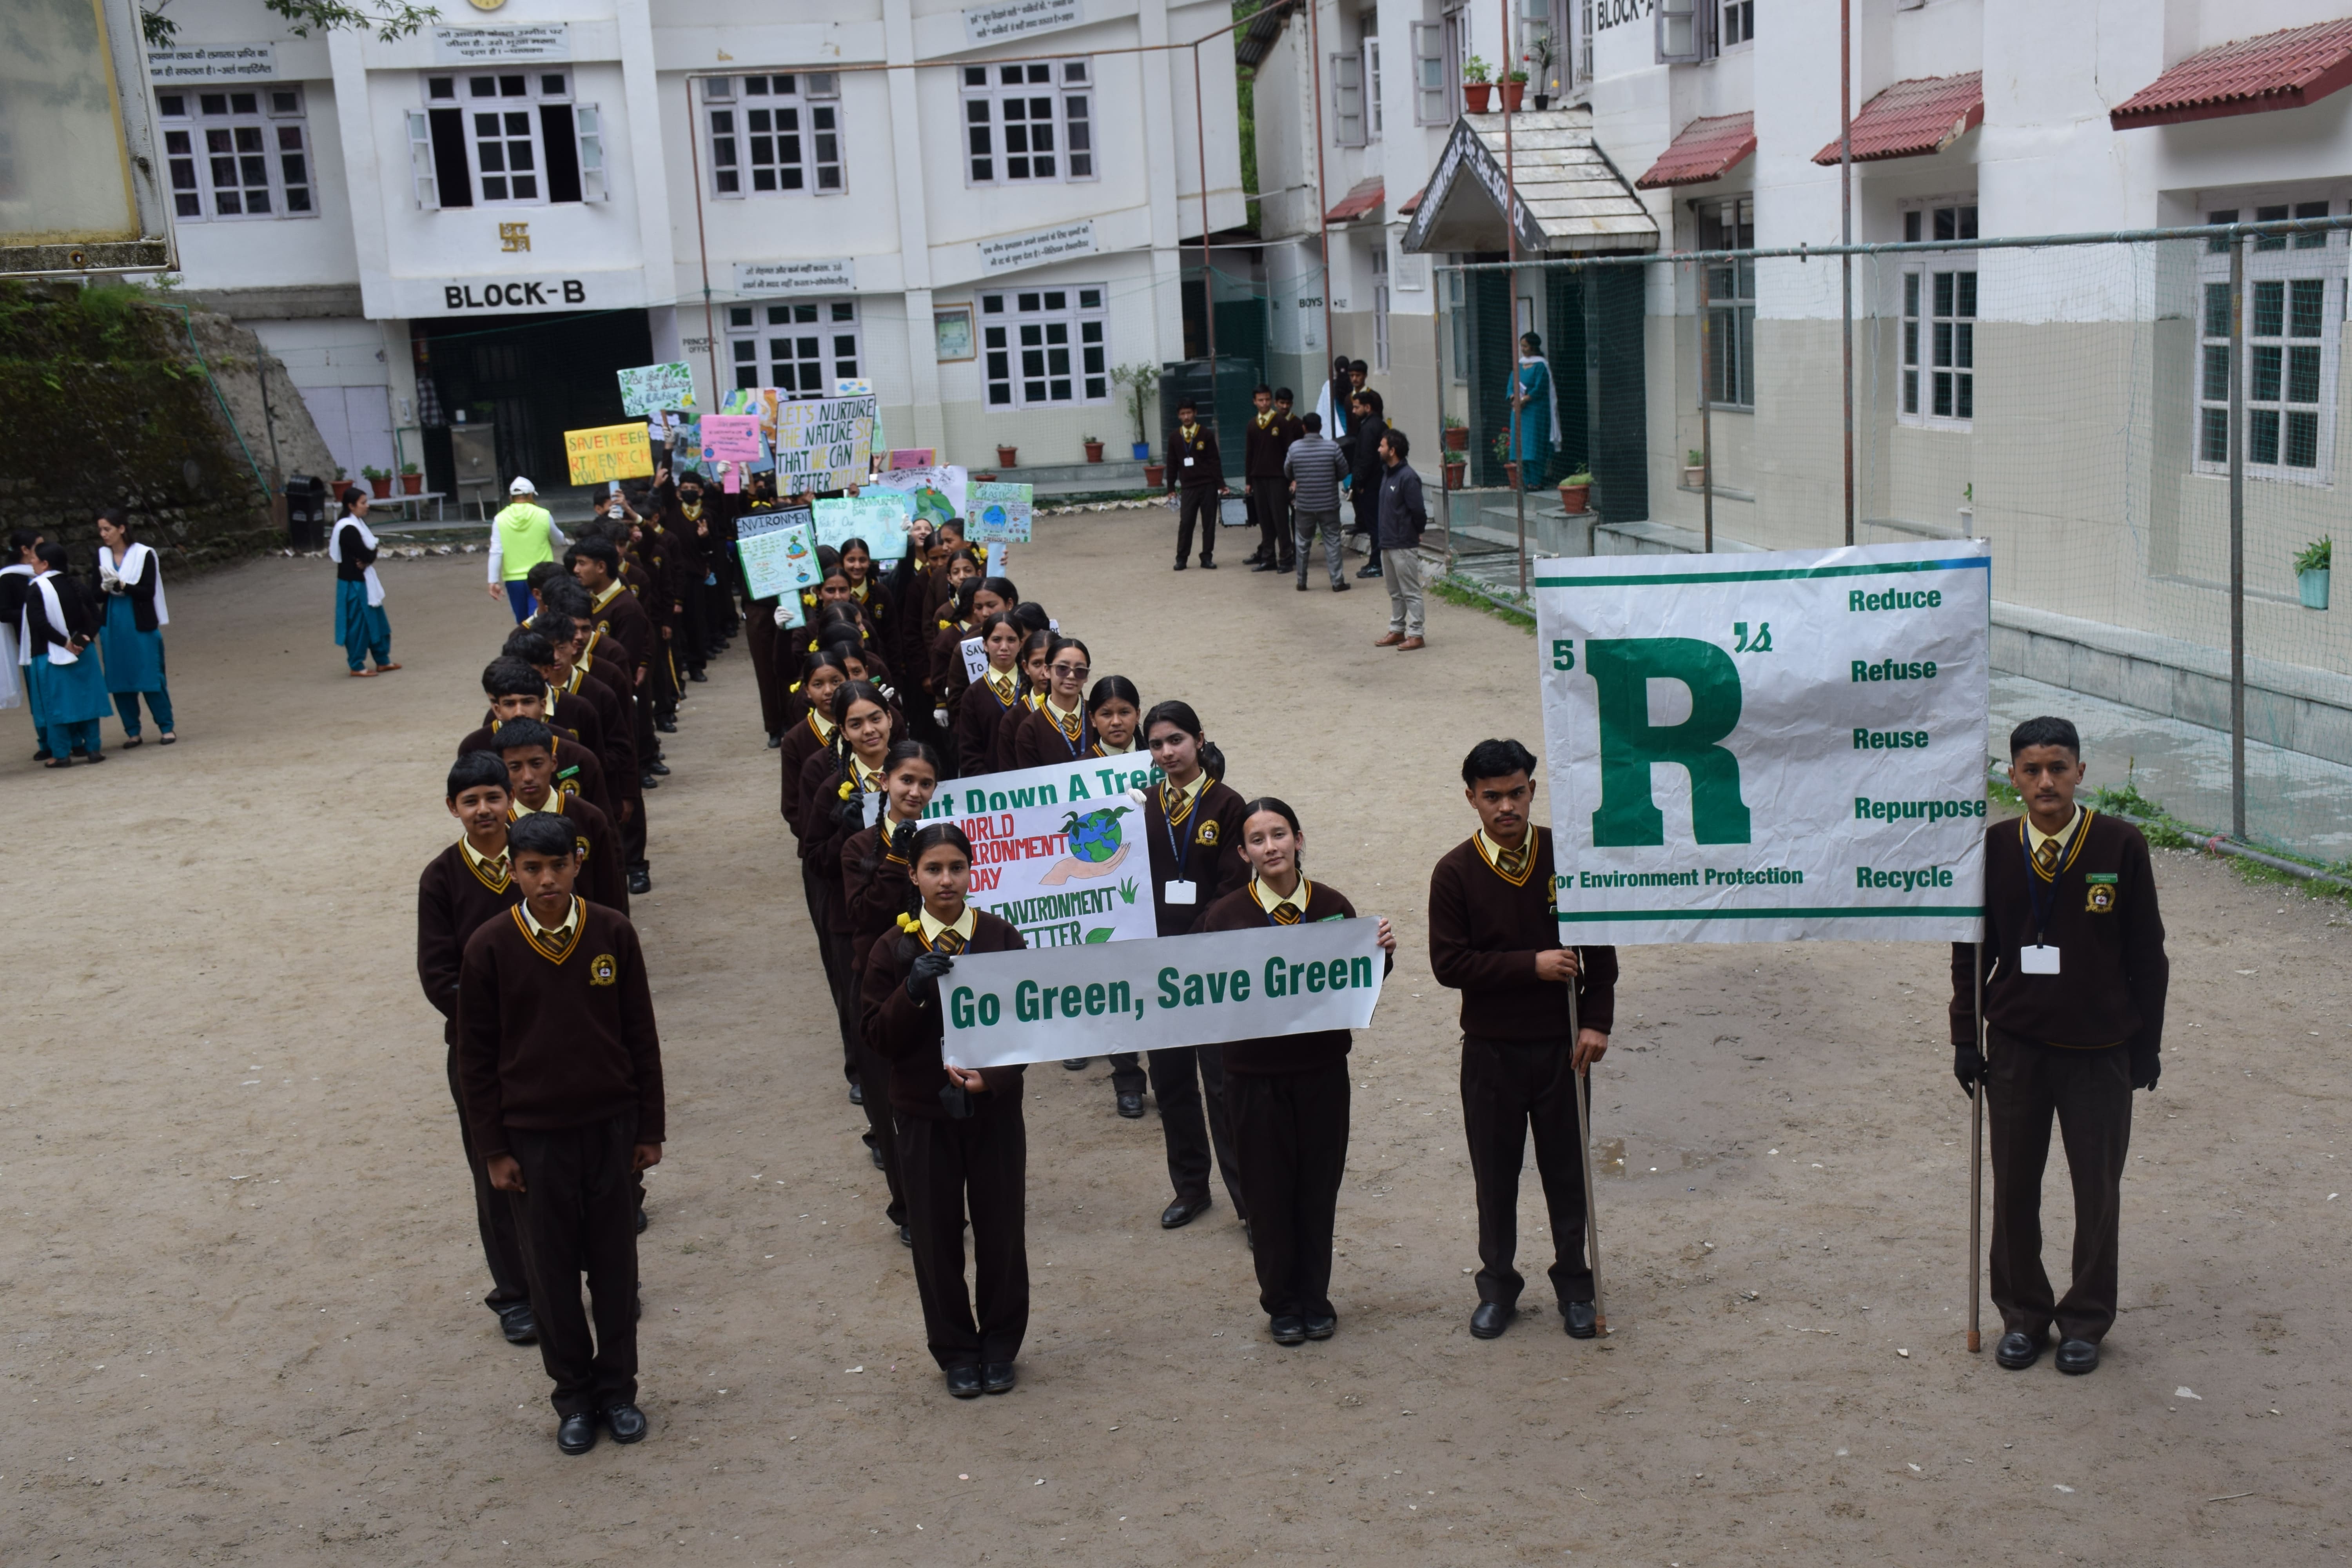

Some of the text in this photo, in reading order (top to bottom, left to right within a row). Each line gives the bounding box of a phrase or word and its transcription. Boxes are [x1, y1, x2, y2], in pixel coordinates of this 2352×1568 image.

[1493, 171, 1526, 238] SCHOL
[1299, 297, 1323, 308] BOYS
[682, 338, 719, 346] PRINCIPL
[820, 399, 874, 421] NURTURE
[779, 418, 872, 448] THE NATURE SO
[777, 451, 809, 474] THAT
[811, 446, 828, 470] WE
[829, 443, 853, 468] CAN
[792, 472, 831, 495] BETTER
[736, 511, 811, 534] ENVIRONMENT
[1848, 588, 1942, 612] Reduce
[1552, 639, 1575, 671] 5
[1851, 659, 1937, 682] Refuse
[1853, 728, 1929, 749] Reuse
[923, 766, 1166, 819] ut Down A Tree
[1854, 797, 1987, 824] Repurpose
[971, 833, 1069, 866] IRONMENT
[968, 867, 1002, 893] DAY
[1555, 867, 1803, 889] or Environment Protection
[1856, 866, 1953, 893] Recycle
[990, 887, 1116, 926] ENVIRONMENT
[1019, 921, 1082, 949] ETTER
[951, 955, 1372, 1029] Go Green, Save Green
